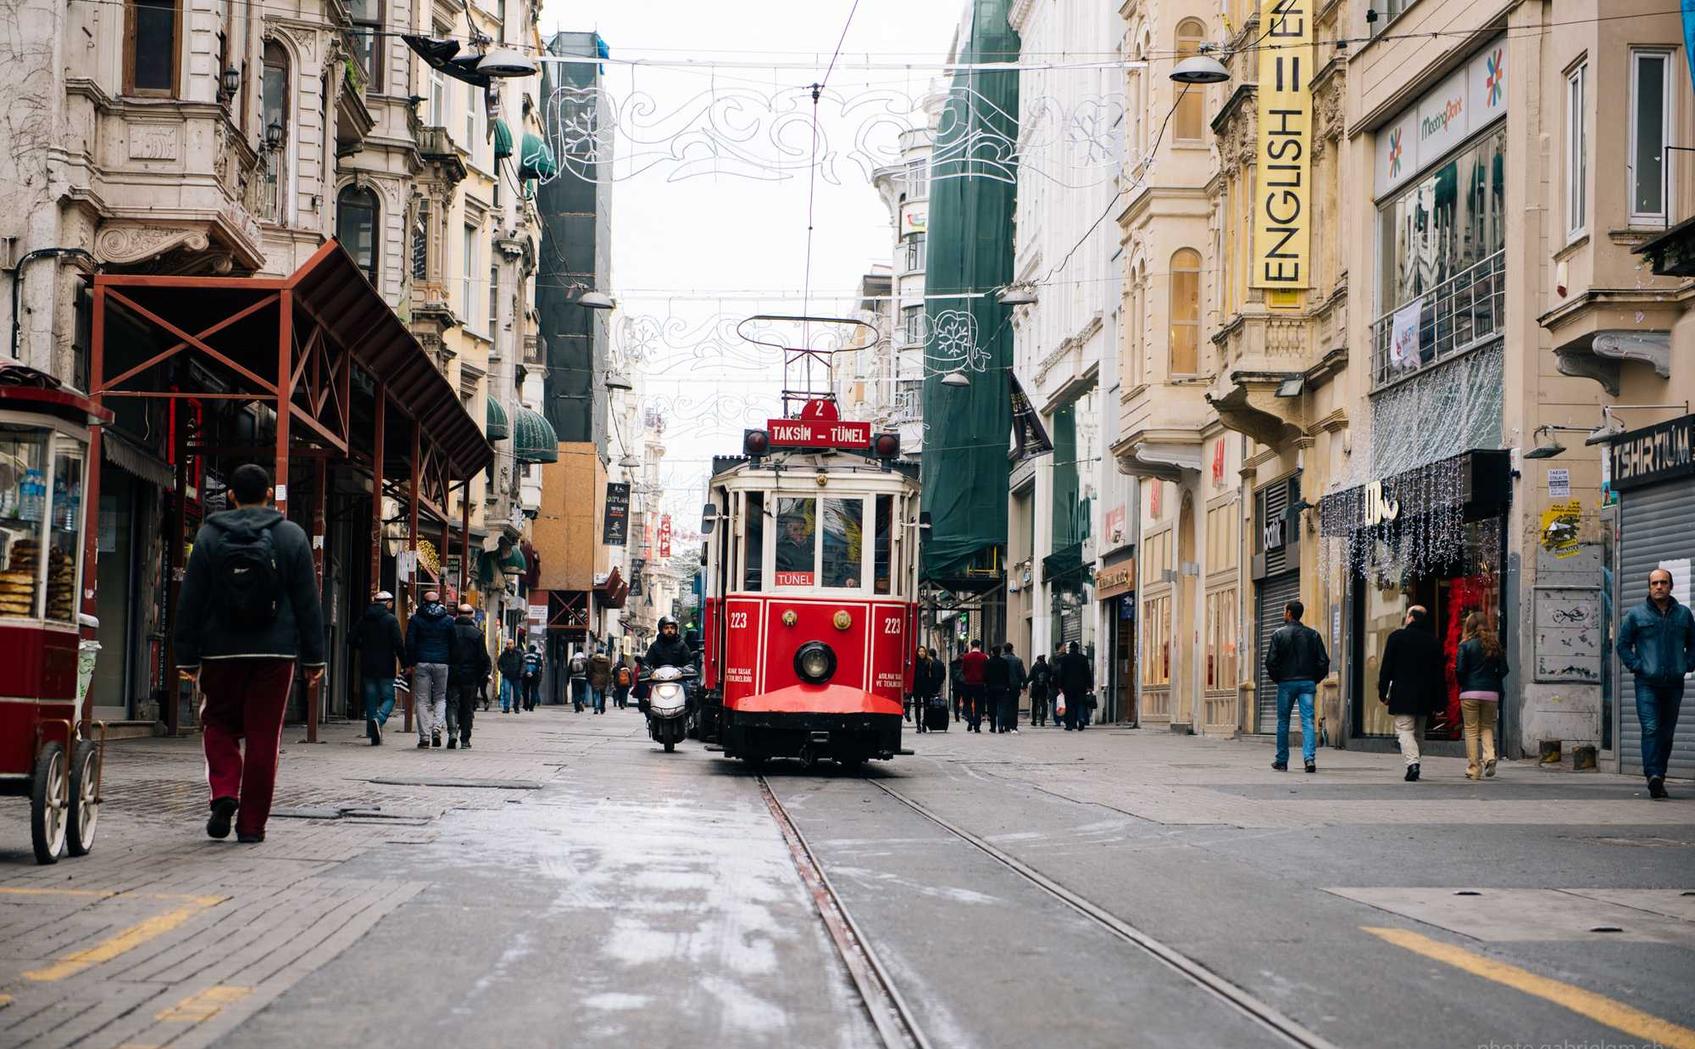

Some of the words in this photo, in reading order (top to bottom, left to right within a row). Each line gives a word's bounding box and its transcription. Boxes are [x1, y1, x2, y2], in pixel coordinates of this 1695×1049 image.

[1265, 109, 1302, 282] ENGLISH
[815, 400, 824, 416] 2
[773, 424, 811, 440] TAKSİM
[831, 426, 866, 443] TÜNEL
[730, 612, 747, 628] 223
[884, 618, 901, 634] 223
